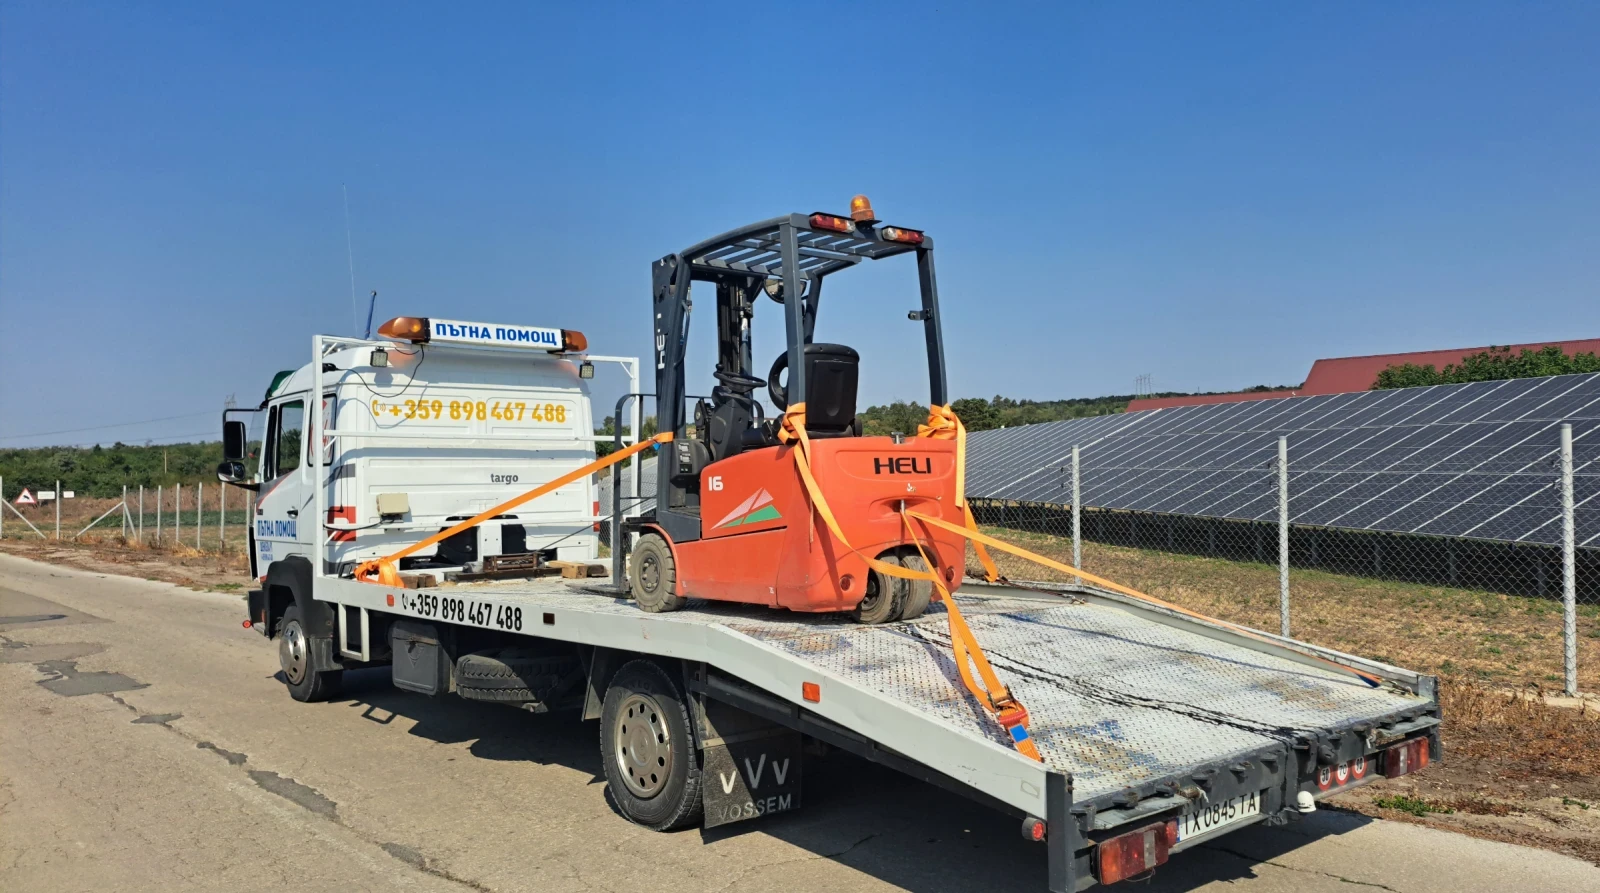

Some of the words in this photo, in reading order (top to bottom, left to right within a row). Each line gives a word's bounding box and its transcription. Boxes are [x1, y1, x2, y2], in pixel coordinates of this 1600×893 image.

[435, 323, 492, 339] ПЪТНА
[496, 328, 557, 346] ПОМОЩ
[388, 399, 443, 420] +359
[450, 400, 487, 421] 898
[490, 401, 526, 421] 467
[531, 403, 567, 423] 488
[873, 457, 932, 475] HELI
[490, 473, 519, 485] targo
[708, 475, 724, 491] 16
[257, 520, 275, 537] ПЪТНА
[275, 520, 297, 540] ПОМОЩ
[409, 593, 439, 617] +359
[442, 597, 465, 622] 898
[468, 601, 493, 627] 467
[496, 604, 523, 631] 488
[719, 793, 792, 820] VOSSEM
[1204, 797, 1236, 828] 0845
[1239, 791, 1257, 815] TA
